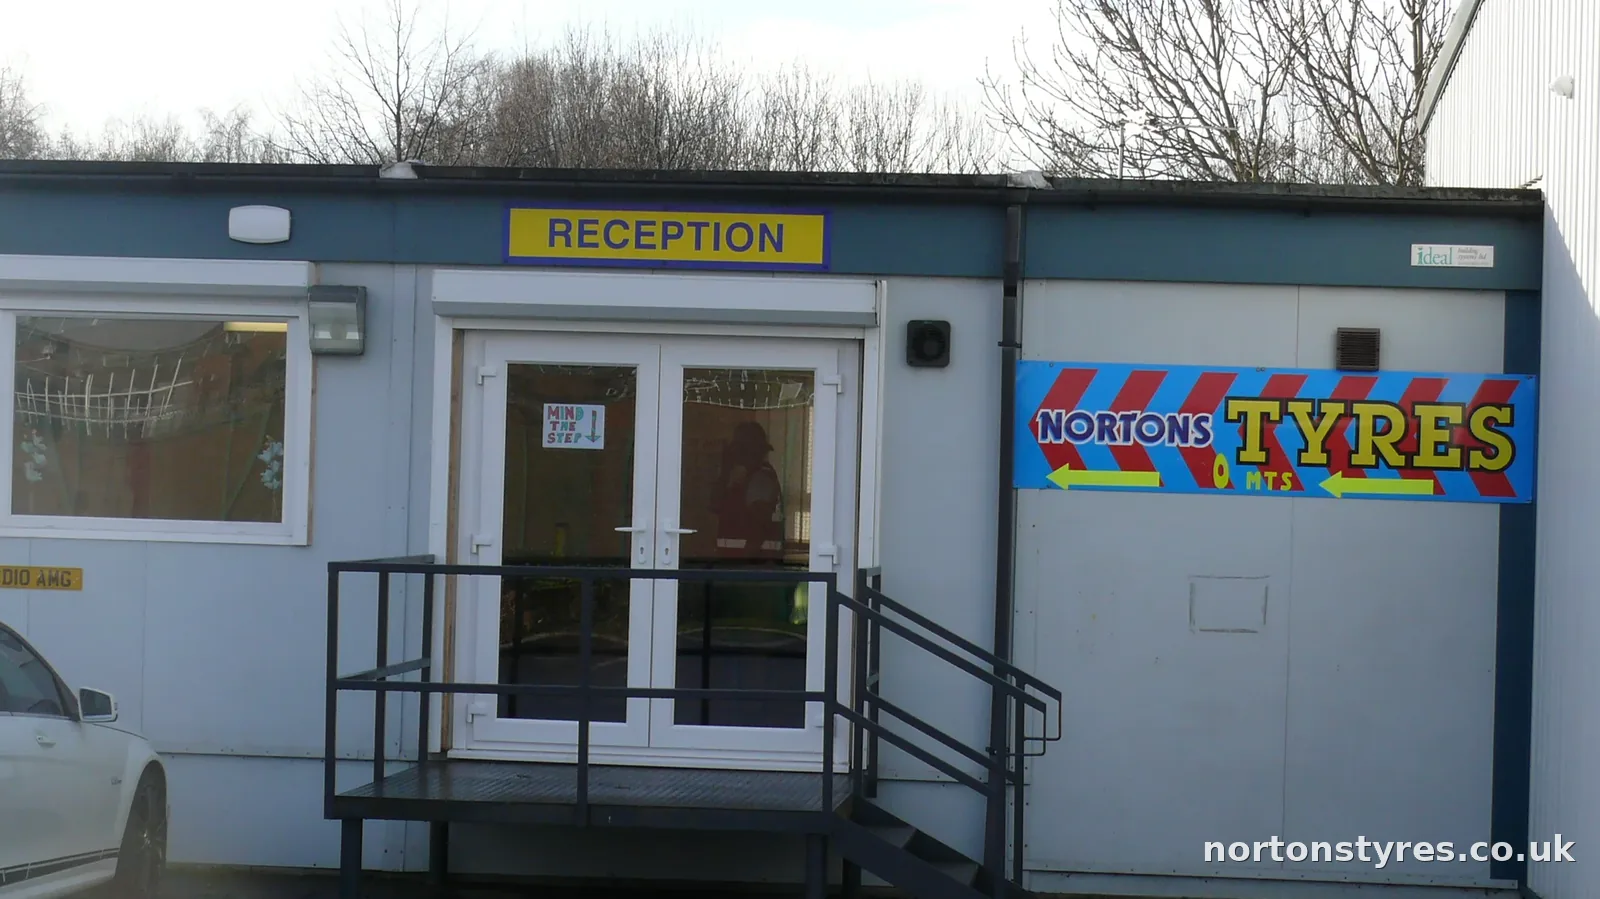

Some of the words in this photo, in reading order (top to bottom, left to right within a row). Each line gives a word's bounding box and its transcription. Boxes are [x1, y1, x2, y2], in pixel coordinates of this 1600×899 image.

[548, 217, 784, 253] RECEPTION
[1417, 246, 1453, 265] ideal
[548, 405, 584, 421] MIND
[547, 432, 582, 444] STEP
[1036, 408, 1213, 448] NORTONS
[1224, 396, 1515, 473] TYRES
[1246, 471, 1293, 490] MTS
[0, 568, 31, 586] D10
[36, 568, 72, 588] AMG
